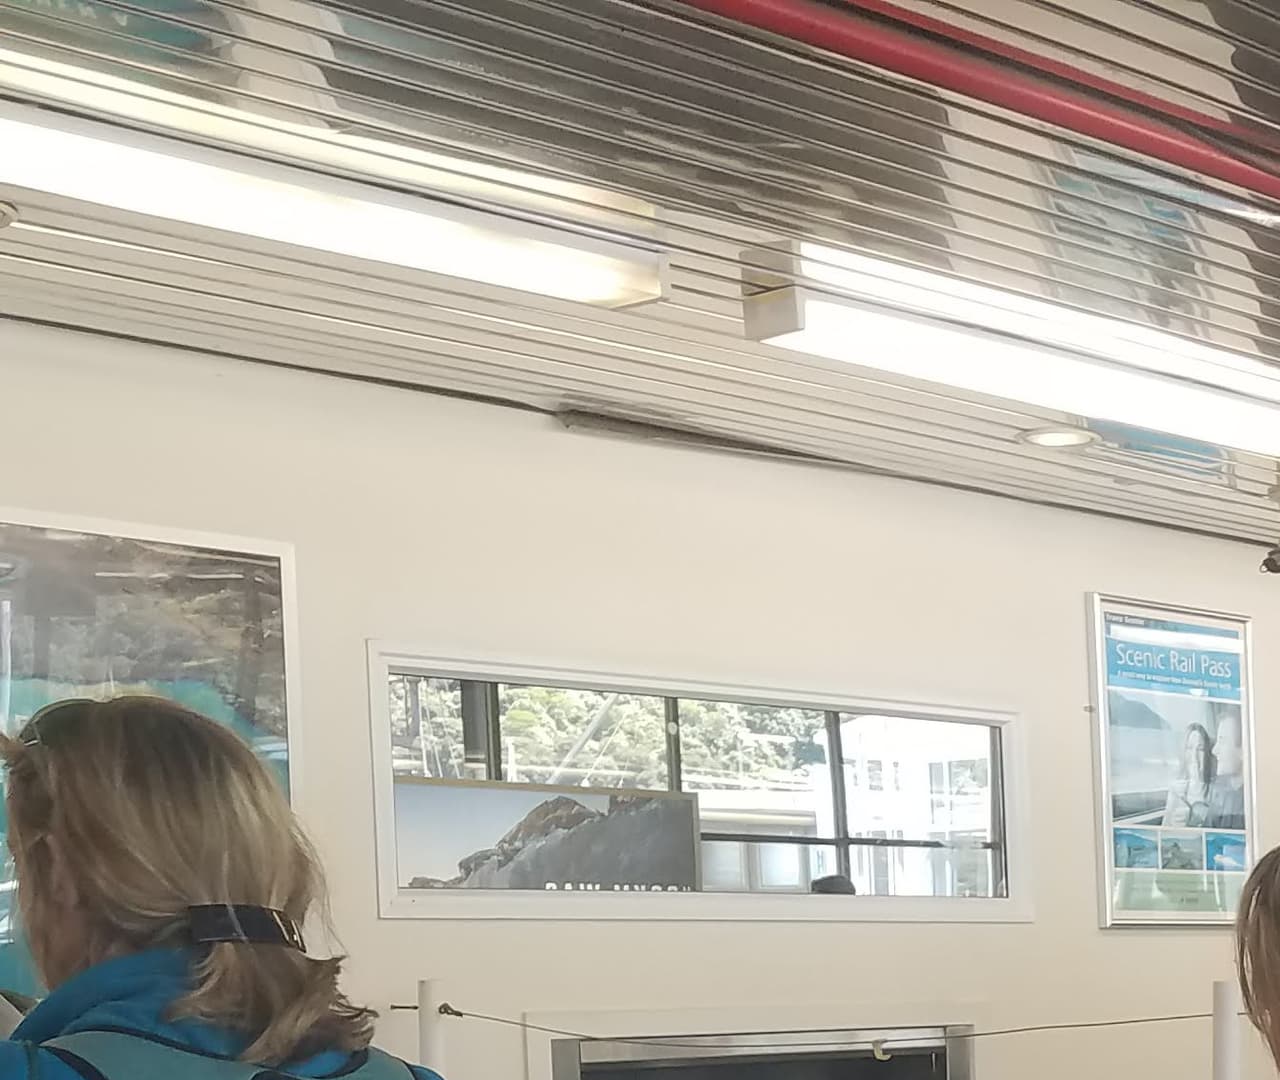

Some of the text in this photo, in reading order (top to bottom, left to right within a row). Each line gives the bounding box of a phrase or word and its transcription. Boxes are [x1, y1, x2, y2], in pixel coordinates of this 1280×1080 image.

[1115, 643, 1232, 678] Scenic Rail Pass
